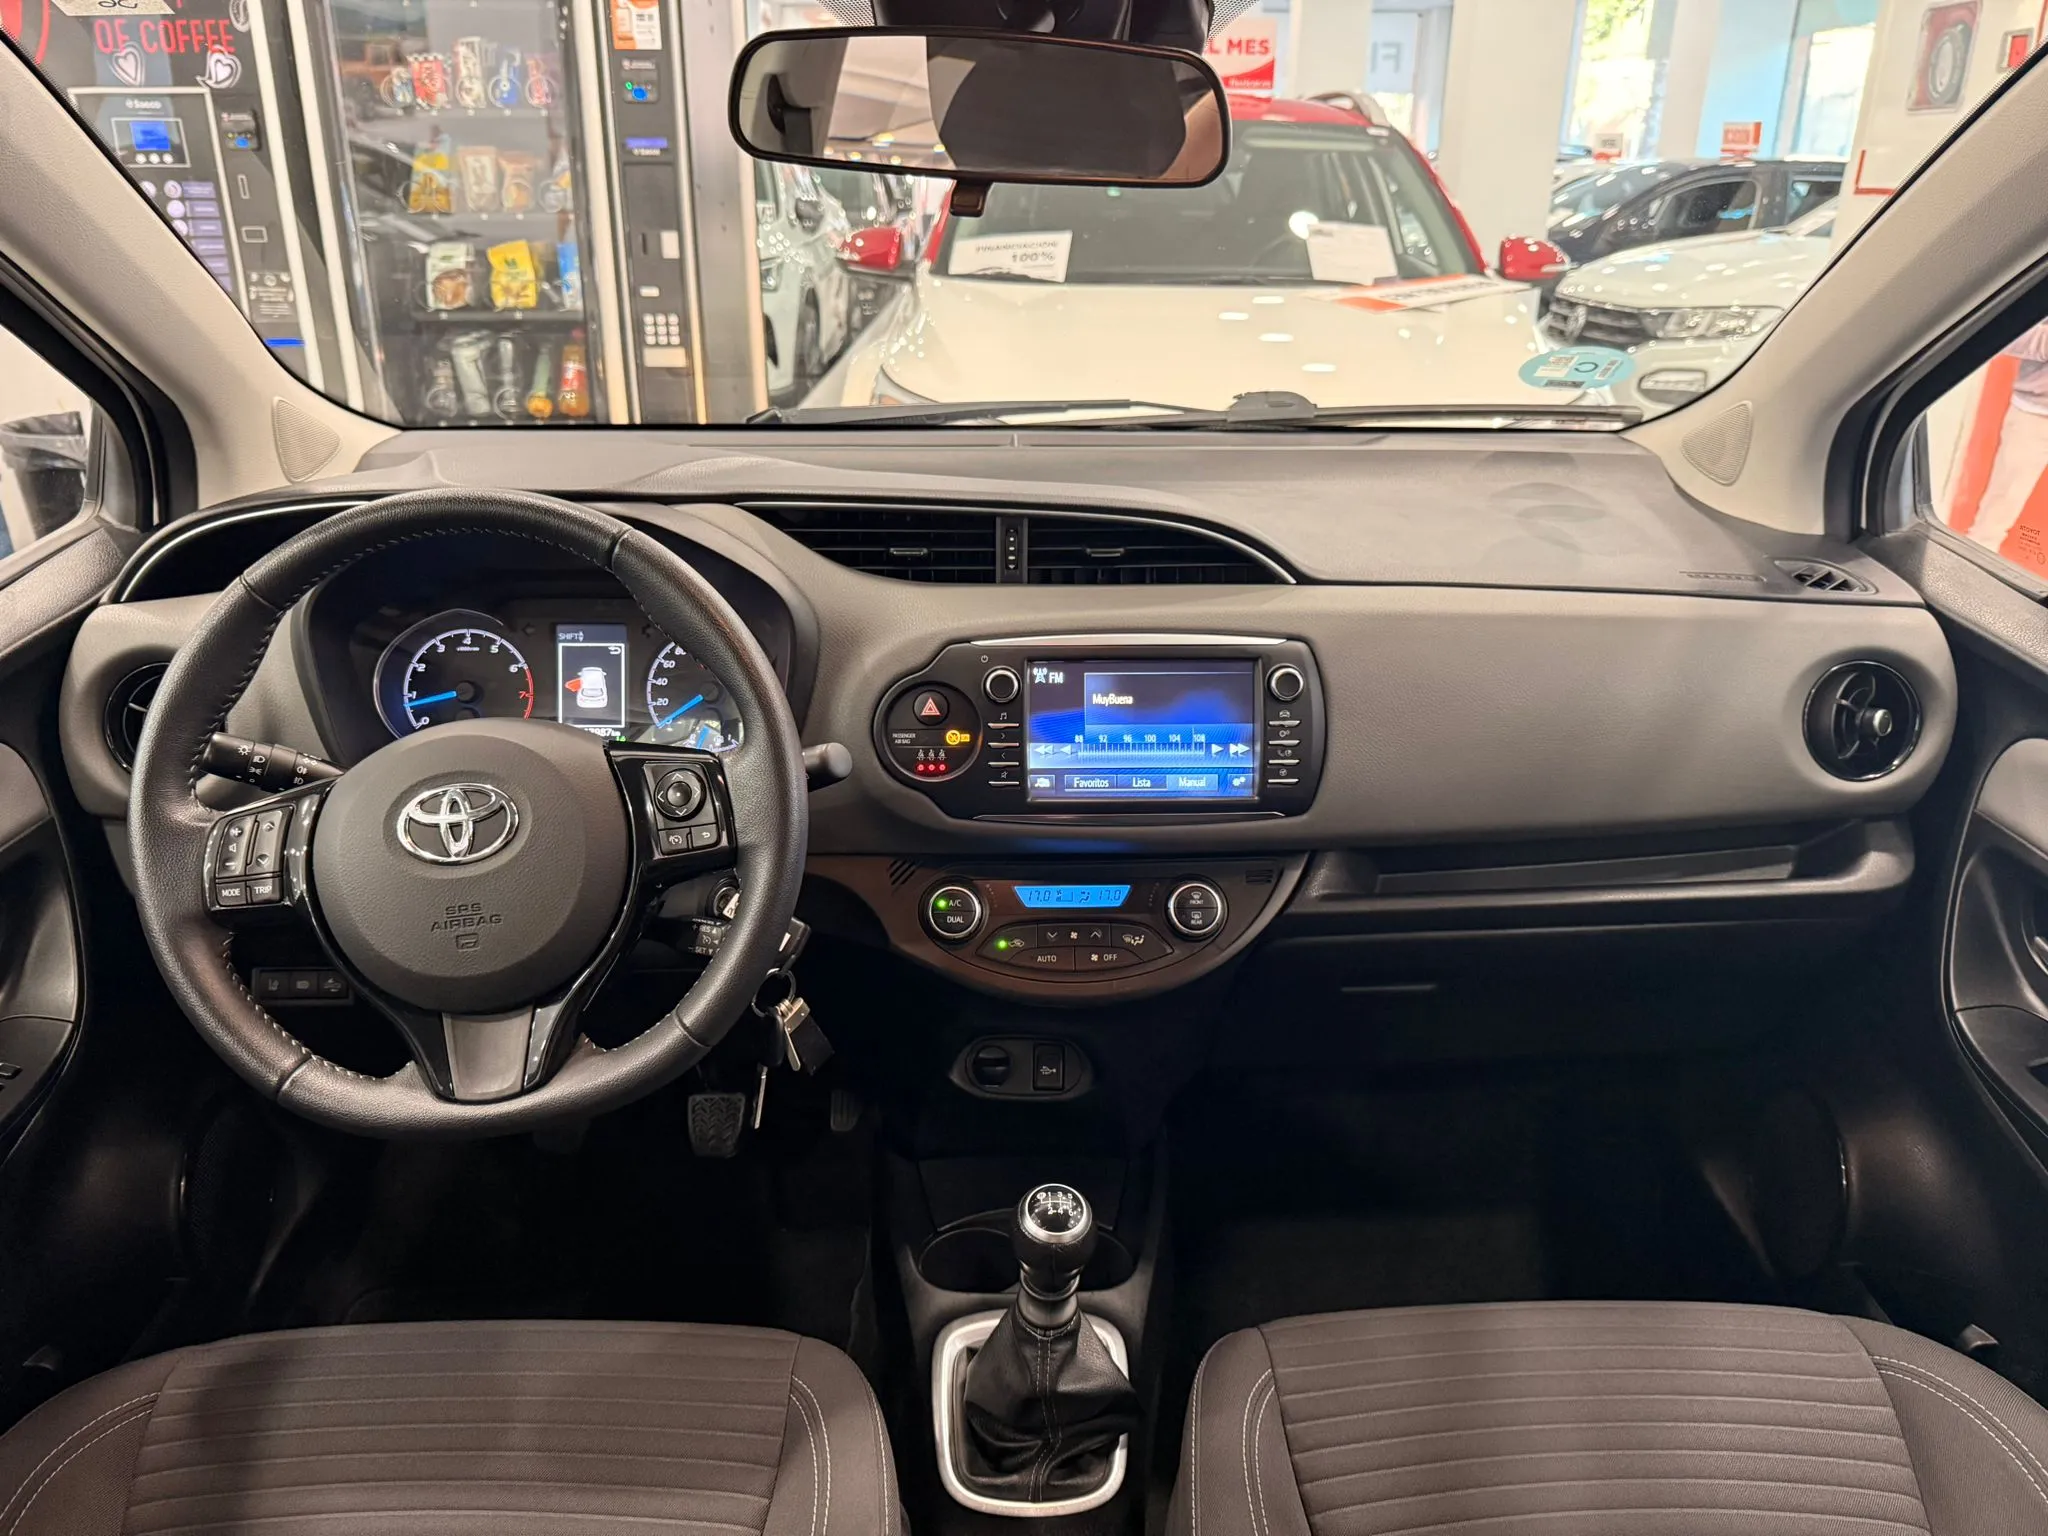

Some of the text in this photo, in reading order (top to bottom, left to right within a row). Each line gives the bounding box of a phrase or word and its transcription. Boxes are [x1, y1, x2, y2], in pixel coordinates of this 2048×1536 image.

[94, 18, 236, 54] OF COFFEE
[1226, 38, 1270, 55] MES
[1011, 251, 1055, 263] 100%
[463, 637, 471, 645] 4
[558, 632, 578, 640] SHIFT
[437, 644, 446, 653] 3
[490, 645, 499, 653] 5
[416, 663, 426, 672] 2
[663, 660, 676, 668] 60
[656, 678, 669, 686] 40
[1048, 671, 1064, 684] FM
[518, 691, 526, 699] 7
[1092, 693, 1133, 707] MuyBuena
[656, 698, 669, 706] 20
[421, 716, 430, 725] 0
[1074, 734, 1206, 743] 88 92 96 100 104 108
[1073, 777, 1109, 788] Favoritos
[1132, 777, 1151, 788] Lista
[1178, 776, 1206, 788] Manual
[221, 887, 241, 897] MODE
[254, 885, 273, 895] TRIP
[1027, 889, 1051, 902] 17.0
[1099, 889, 1122, 902] 17.0
[948, 898, 962, 908] A/C
[445, 903, 482, 916] SRS
[430, 914, 502, 932] AIRBAG
[946, 914, 965, 924] DUAL
[1037, 954, 1057, 962] AUTO
[1103, 954, 1118, 962] OFF
